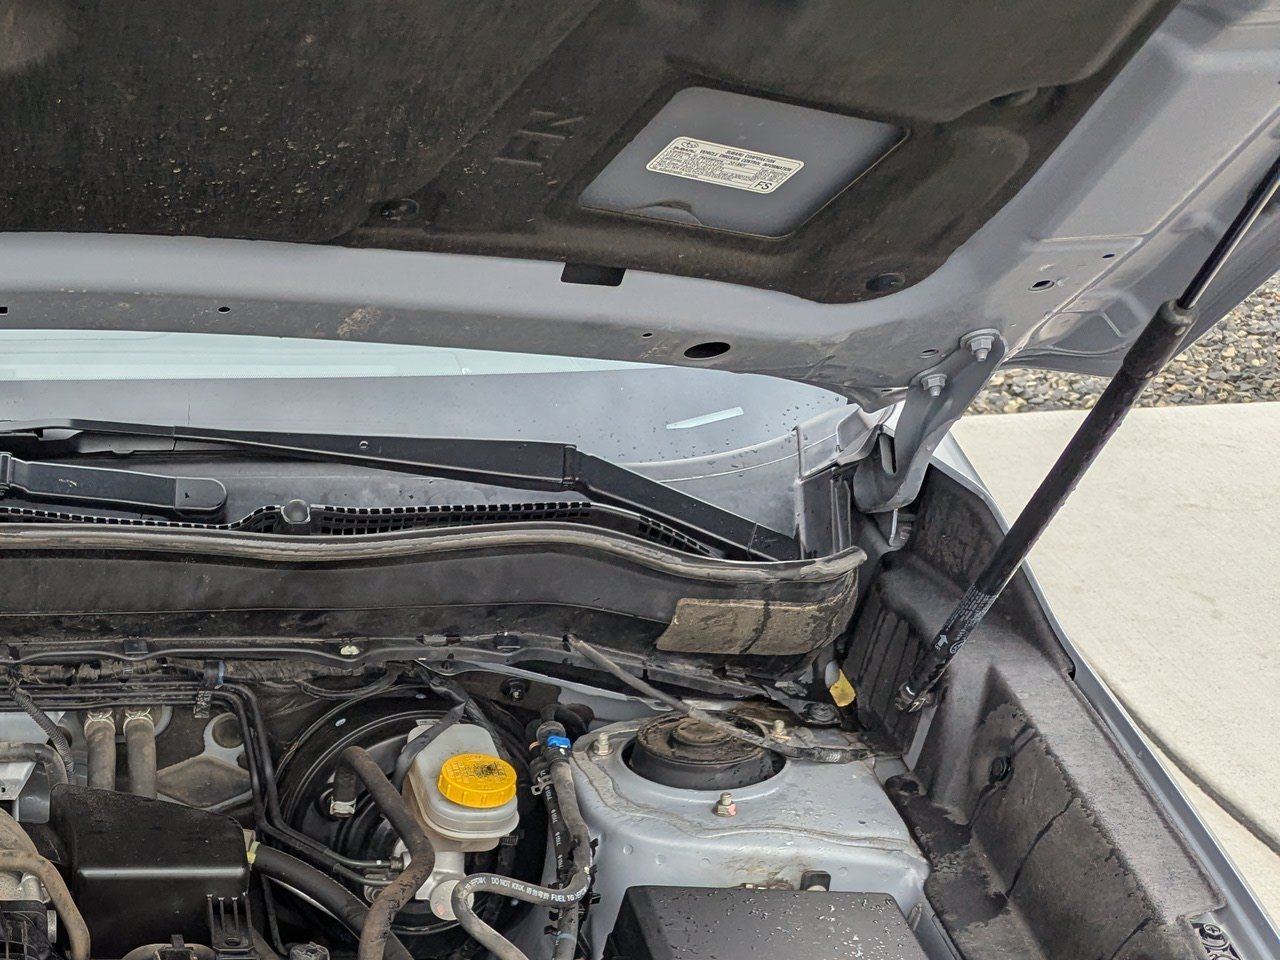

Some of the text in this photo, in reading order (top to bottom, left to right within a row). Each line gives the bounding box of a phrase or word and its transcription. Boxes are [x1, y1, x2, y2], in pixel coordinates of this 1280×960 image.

[754, 181, 772, 191] FS
[490, 876, 499, 884] DO
[499, 878, 511, 887] NOT
[550, 893, 566, 902] FUEL
